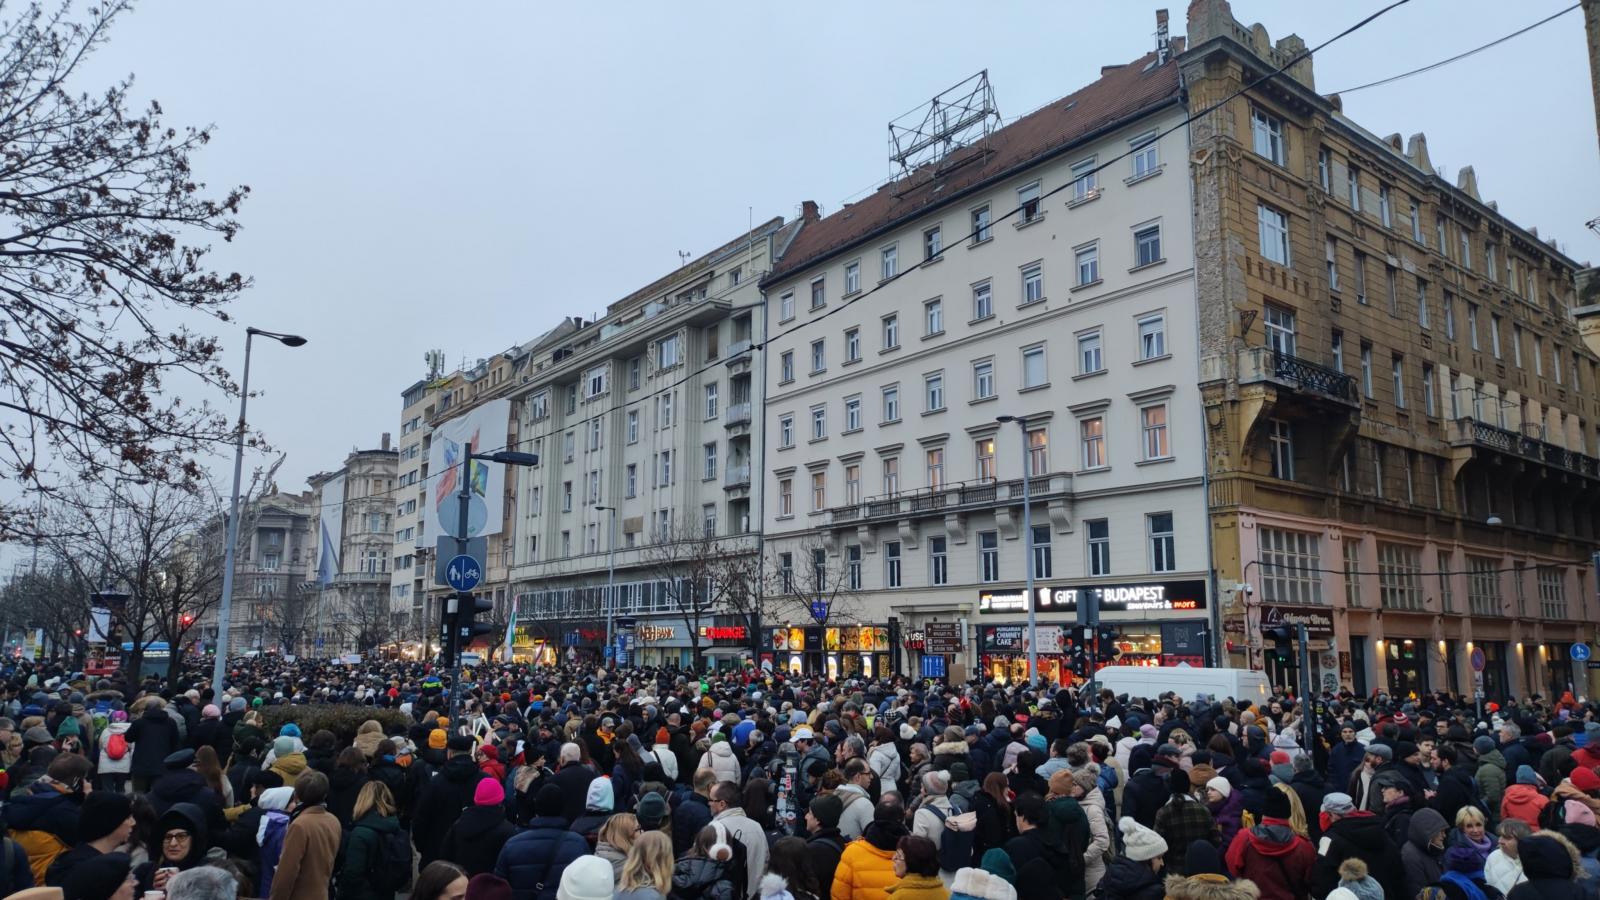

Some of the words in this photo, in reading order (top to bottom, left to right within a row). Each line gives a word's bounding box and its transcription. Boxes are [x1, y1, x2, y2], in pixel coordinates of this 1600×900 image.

[1054, 589, 1078, 604] GIFT
[1104, 586, 1165, 600] BUDAPEST
[1126, 600, 1164, 610] souvenirs
[1164, 599, 1173, 609] &
[1174, 600, 1196, 609] more
[996, 638, 1012, 646] CAKE
